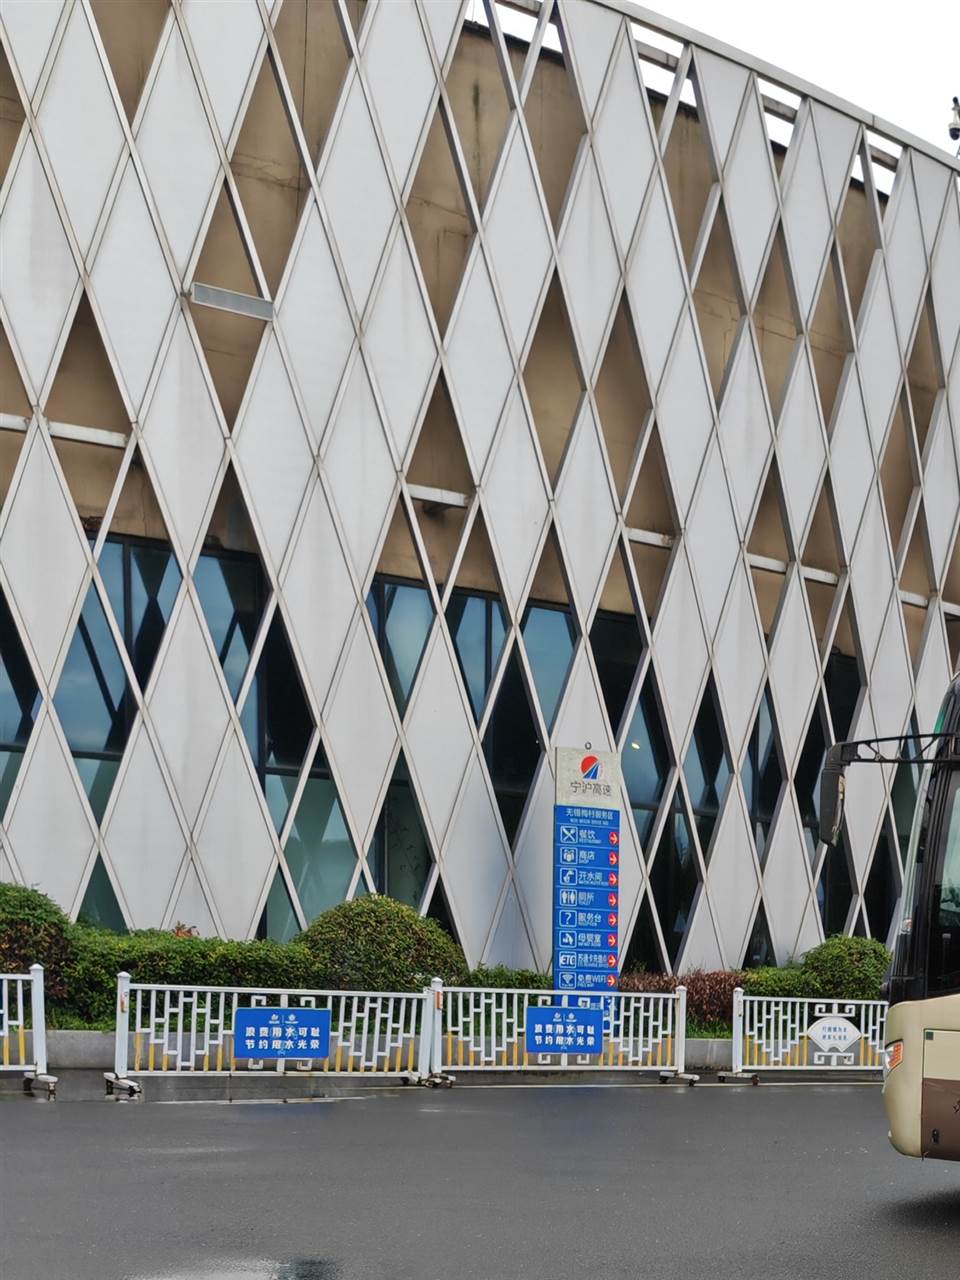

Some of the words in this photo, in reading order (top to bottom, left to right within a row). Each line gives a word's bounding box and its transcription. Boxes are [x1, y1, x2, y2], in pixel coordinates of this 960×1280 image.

[570, 781, 611, 796] 宁沪高速
[579, 829, 596, 840] 餐饮
[579, 850, 595, 861] 商店
[578, 871, 603, 882] 开水间
[578, 912, 602, 923] 服务台
[578, 933, 601, 944] 母婴室
[560, 955, 576, 966] ETC
[245, 1027, 320, 1038] 浪费用水可耻
[534, 1024, 595, 1035] 浪费用水可耻
[245, 1039, 320, 1050] 节约用水光荣
[534, 1035, 595, 1046] 节约用水光荣
